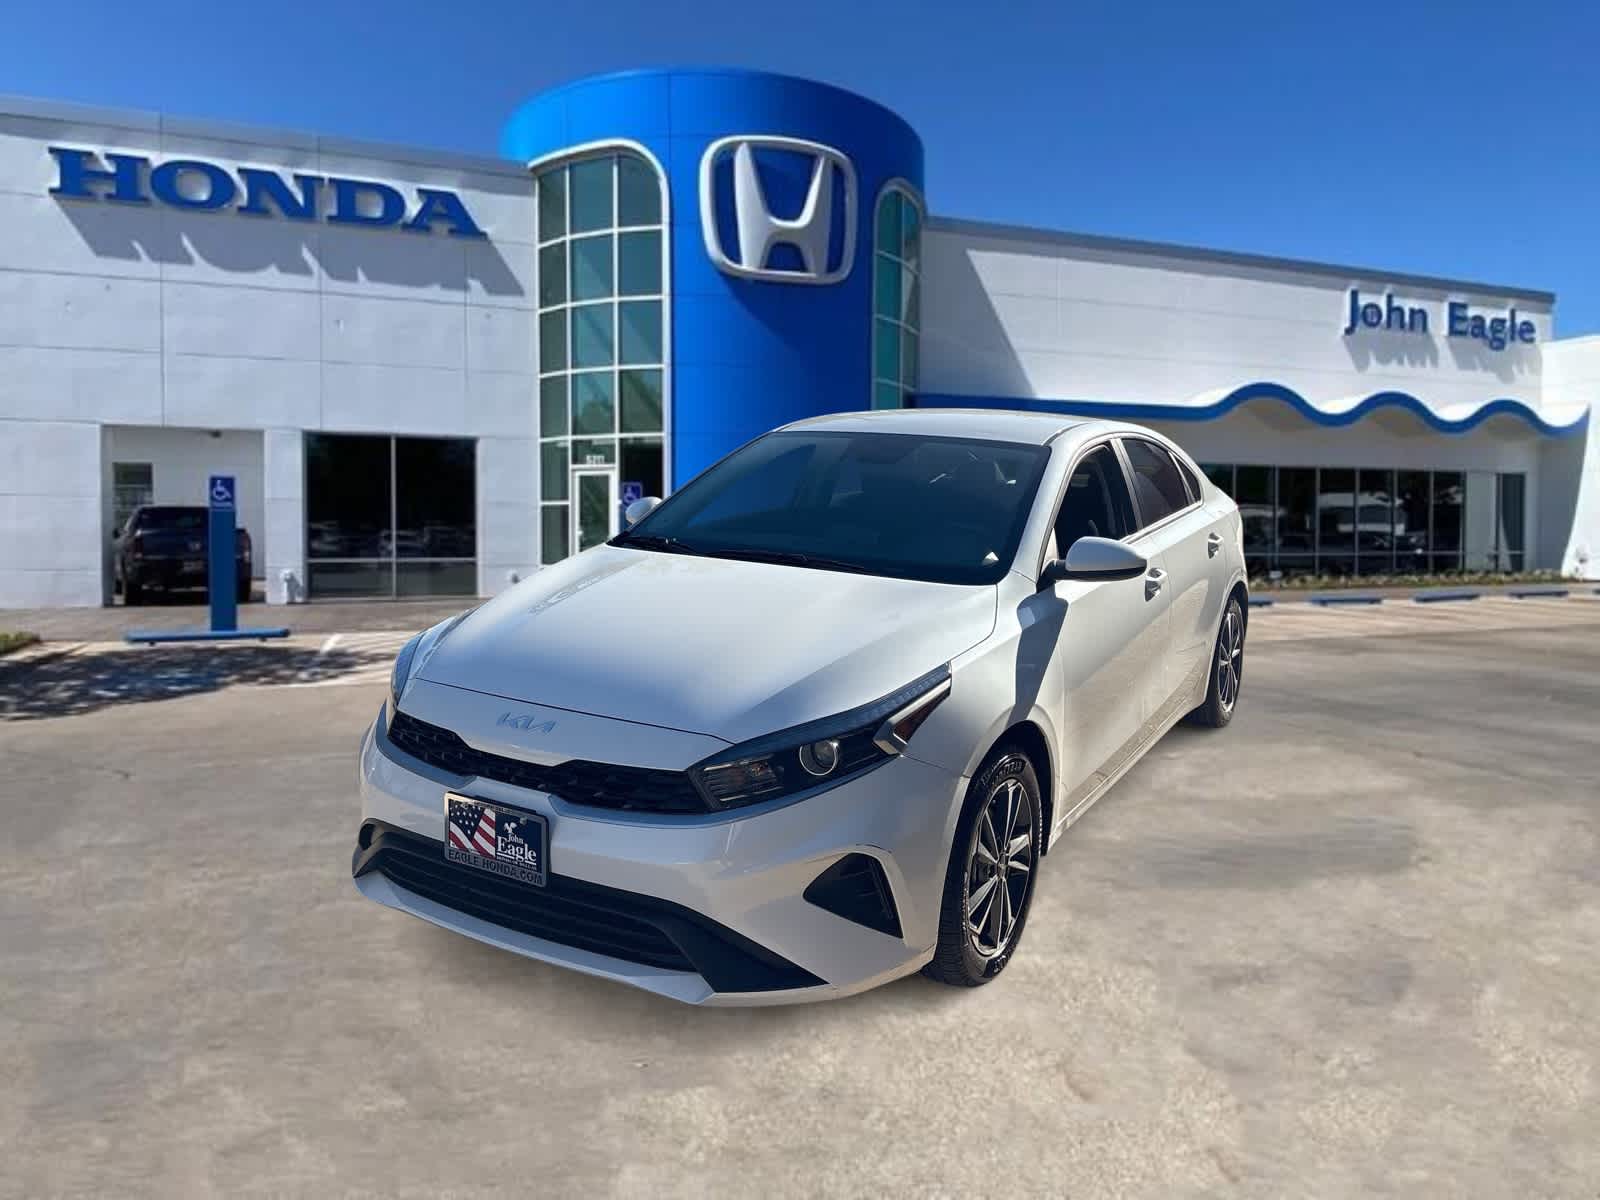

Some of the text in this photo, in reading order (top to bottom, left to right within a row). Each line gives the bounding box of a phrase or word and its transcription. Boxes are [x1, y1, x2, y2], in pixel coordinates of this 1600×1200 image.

[48, 146, 487, 237] HONDA
[1344, 289, 1536, 351] John Eagle
[496, 836, 537, 862] Eagle
[508, 834, 524, 844] John
